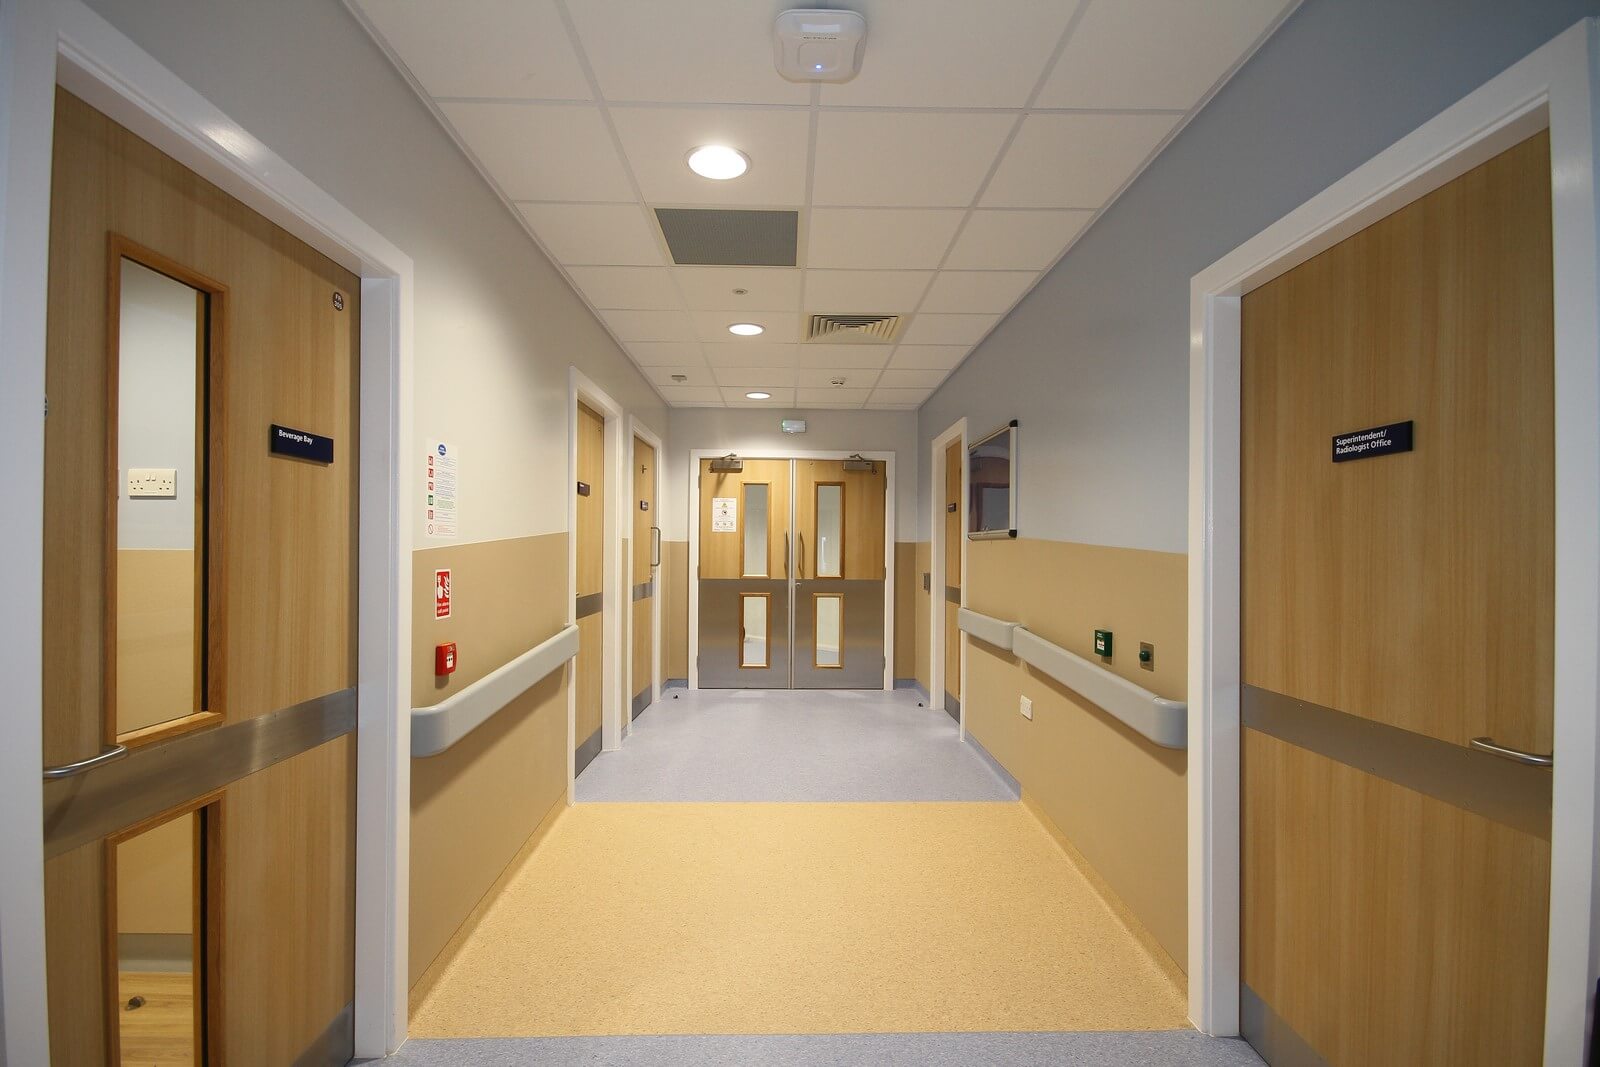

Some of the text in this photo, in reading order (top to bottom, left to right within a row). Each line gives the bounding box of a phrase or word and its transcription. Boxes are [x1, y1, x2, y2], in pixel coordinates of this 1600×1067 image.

[279, 429, 313, 445] Beverage Bay
[1336, 430, 1387, 446] Superintendent/
[1336, 439, 1392, 455] Radiologist Office
